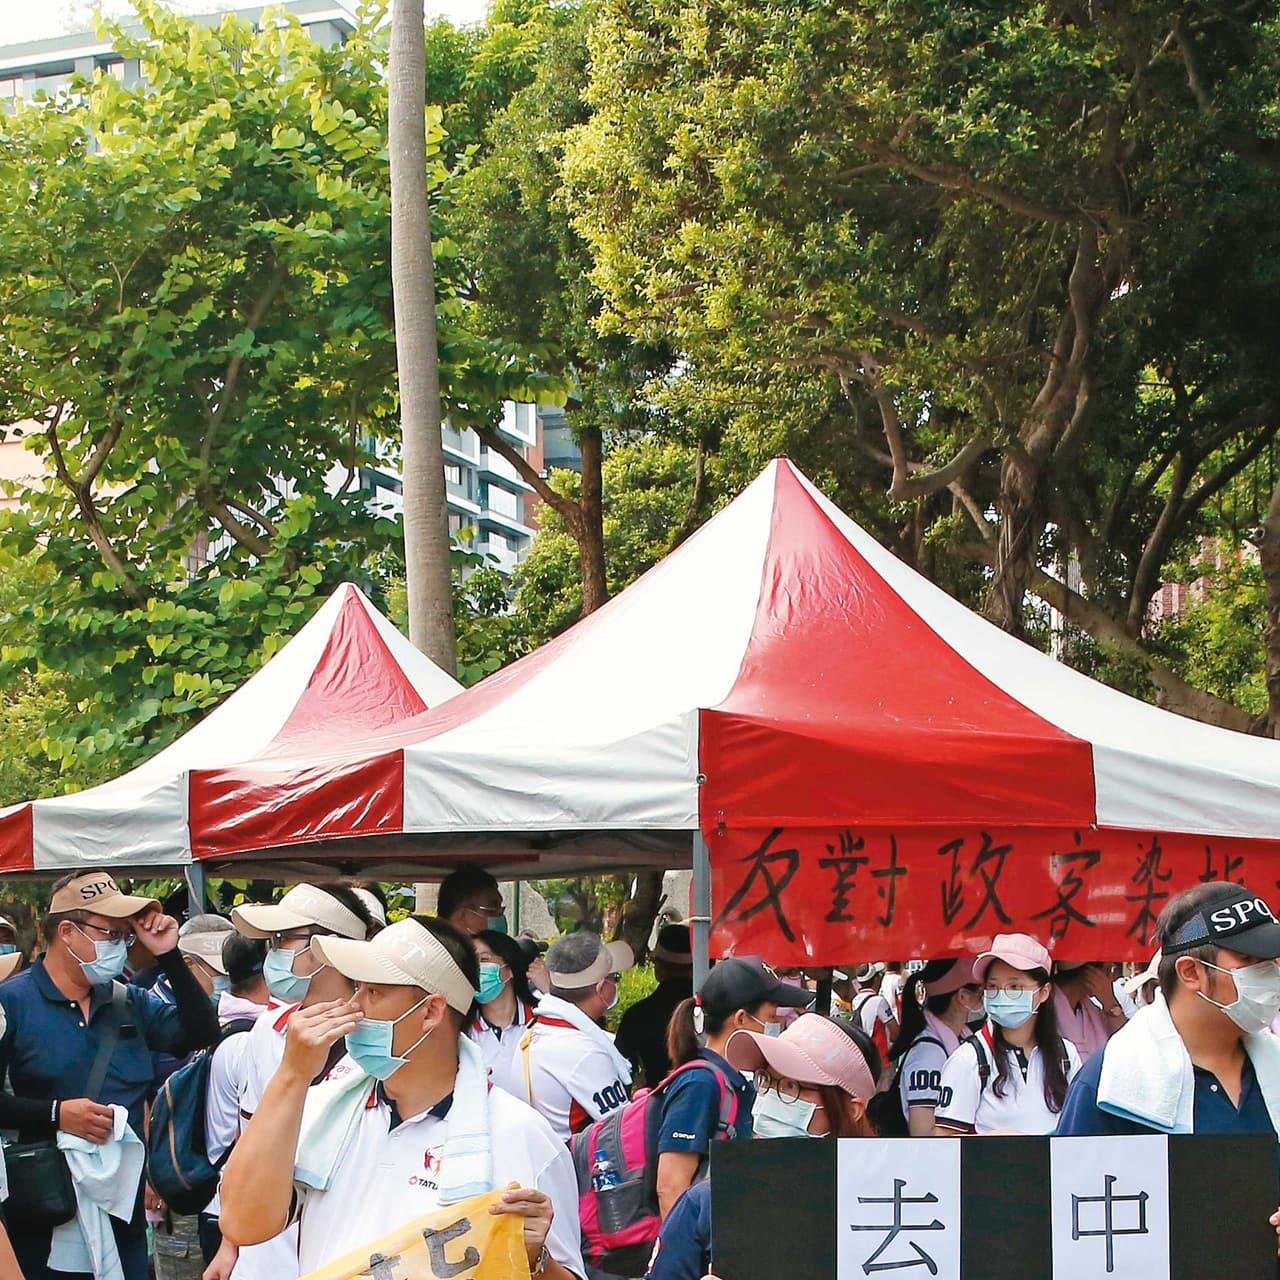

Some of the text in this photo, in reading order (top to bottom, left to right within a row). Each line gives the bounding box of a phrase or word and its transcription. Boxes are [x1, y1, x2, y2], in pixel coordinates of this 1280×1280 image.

[1211, 898, 1279, 932] SPO
[593, 1080, 626, 1115] 100
[909, 1070, 941, 1091] 100
[850, 1174, 1150, 1277] 去中
